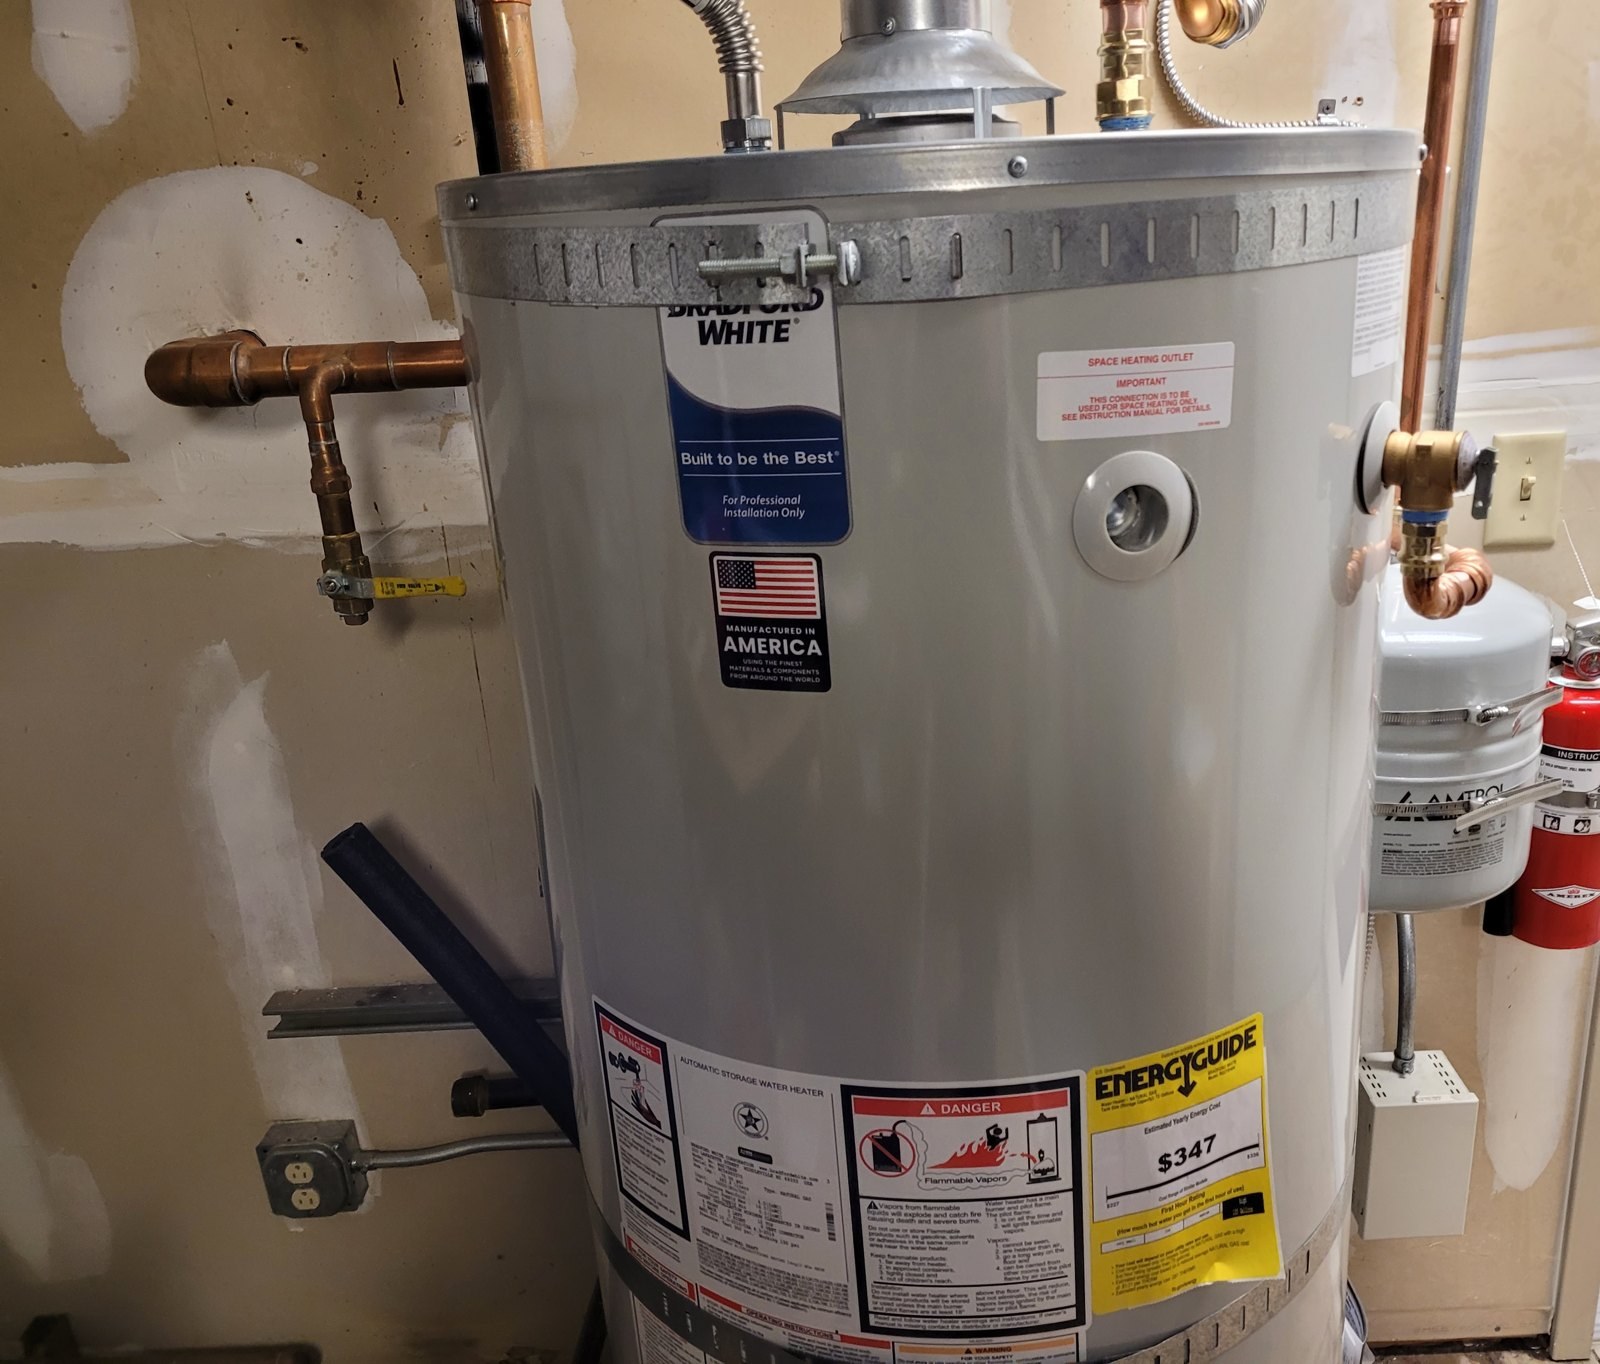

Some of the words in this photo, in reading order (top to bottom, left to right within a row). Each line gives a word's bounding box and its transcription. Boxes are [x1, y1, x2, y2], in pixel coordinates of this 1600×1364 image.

[698, 319, 791, 346] WHITE
[1088, 357, 1118, 367] SPACE
[1120, 355, 1159, 365] HEATING
[1160, 353, 1194, 363] OUTLET
[1116, 377, 1166, 388] IMPORTANT
[1090, 396, 1107, 404] THIS
[1108, 393, 1158, 403] CONNECTION
[1169, 391, 1178, 399] TO
[1078, 404, 1100, 412] USED
[1101, 402, 1118, 410] FOR
[1119, 401, 1144, 409] SPACE
[1146, 398, 1177, 407] HEATING
[1061, 413, 1077, 421] SEE
[1079, 409, 1131, 420] INSTRUCTION
[1132, 407, 1162, 416] MANUAL
[1165, 406, 1180, 414] FOR
[681, 453, 712, 465] Built
[717, 453, 732, 464] to
[737, 452, 757, 464] be
[763, 452, 788, 464] the
[723, 495, 738, 504] For
[739, 495, 801, 504] Professional
[724, 508, 779, 517] Installation
[781, 508, 805, 519] Only
[726, 624, 802, 634] MANUFACTURED
[724, 636, 822, 656] AMERICA
[772, 667, 819, 675] COMPONENTS
[1558, 750, 1600, 761] INSTRUC
[618, 1031, 653, 1057] DANGER
[1096, 1025, 1257, 1100] ENERGYGUIDE
[680, 1056, 719, 1075] AUTOMATIC
[721, 1069, 757, 1085] STORAGE
[758, 1079, 788, 1092] WATER
[789, 1086, 824, 1097] HEATER
[941, 1102, 1001, 1114] DANGER
[1144, 1119, 1172, 1134] Estimated
[1173, 1114, 1189, 1126] Yearly
[1189, 1108, 1207, 1120] Energy
[1208, 1101, 1221, 1113] Cost
[1158, 1133, 1217, 1174] $347
[975, 1176, 1007, 1184] Vapors
[879, 1202, 903, 1210] Vapors
[1161, 1205, 1174, 1214] First
[1174, 1201, 1187, 1210] Hour
[1188, 1192, 1206, 1205] Rating
[867, 1208, 889, 1216] liquids
[903, 1211, 931, 1219] explode
[867, 1216, 894, 1224] causing
